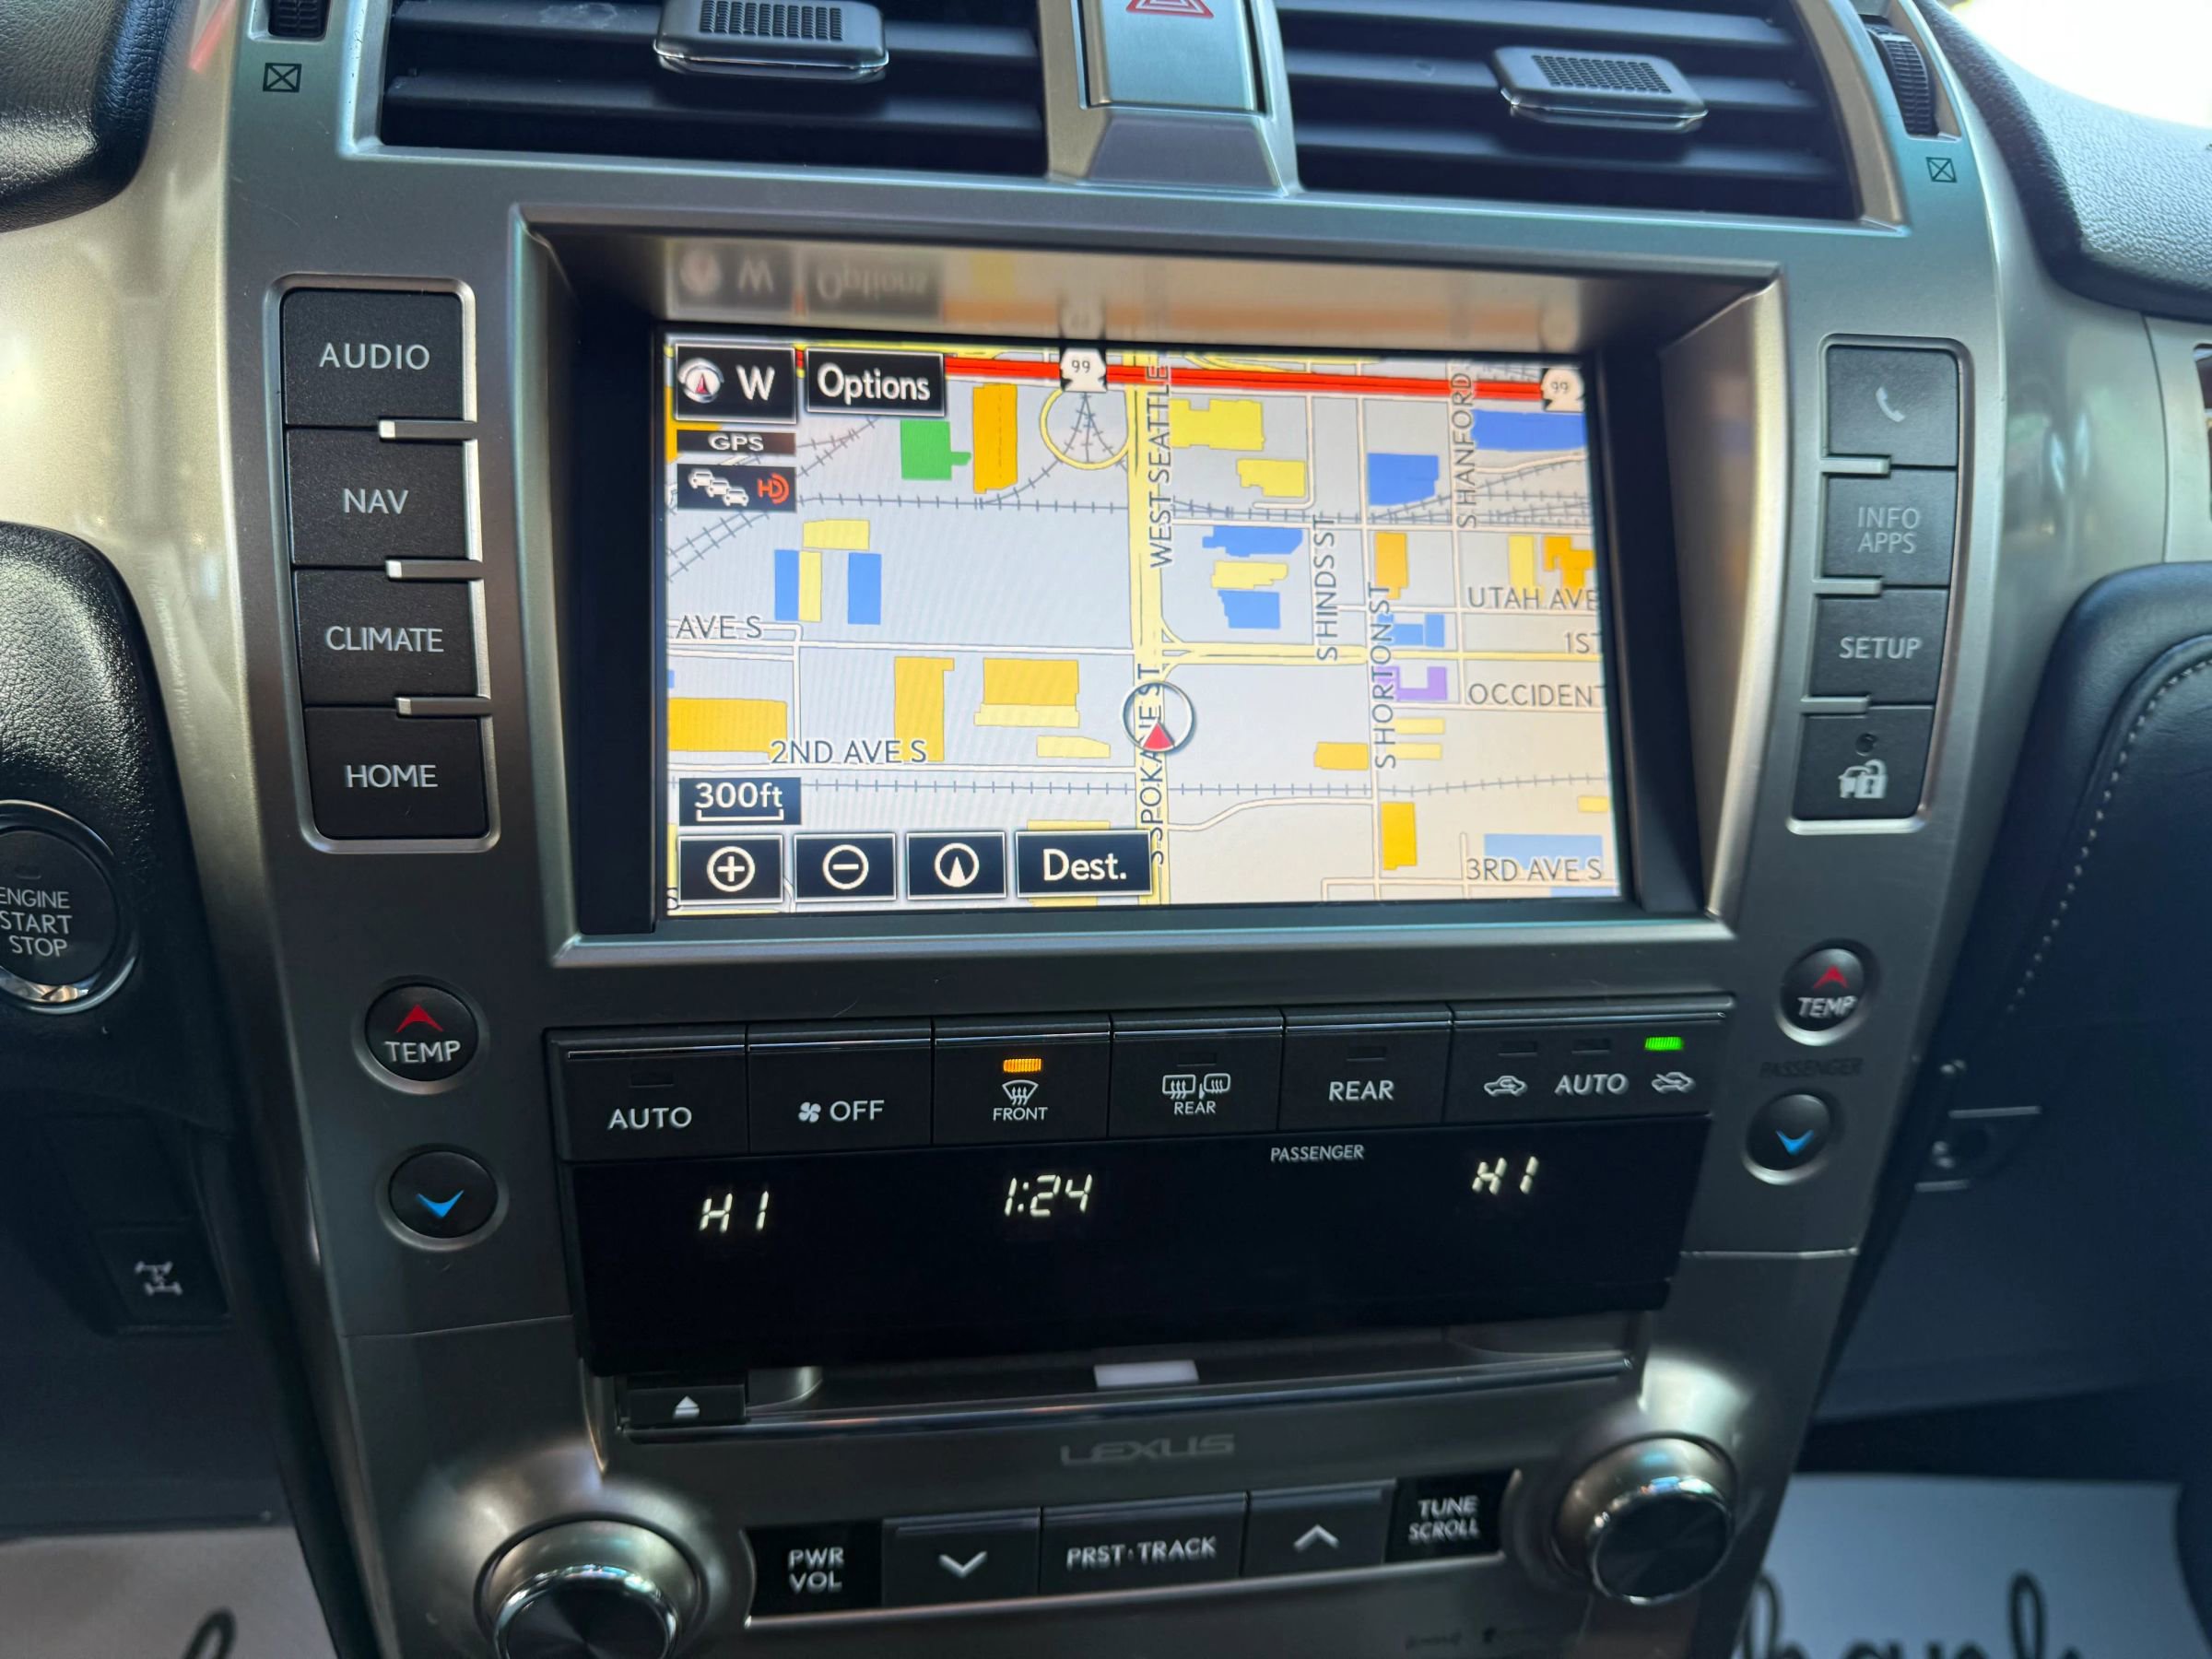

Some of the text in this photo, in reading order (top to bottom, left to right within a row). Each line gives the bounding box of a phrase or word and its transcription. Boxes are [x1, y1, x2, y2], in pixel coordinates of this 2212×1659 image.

[319, 342, 430, 371] AUDIO
[1071, 359, 1091, 373] 99
[736, 365, 776, 400] W
[817, 361, 931, 406] Options
[1550, 381, 1570, 393] 99
[708, 432, 764, 452] GPS
[1450, 372, 1477, 506] HANFORD
[1146, 365, 1173, 569] WEST SEATTLE
[342, 488, 410, 515] NAV
[1456, 514, 1477, 529] S
[1856, 505, 1921, 529] INFO
[1856, 531, 1918, 555] APPS
[1312, 514, 1338, 662] S HINDS ST
[1467, 586, 1540, 610] UTAH
[324, 625, 445, 653] CLIMATE
[676, 615, 763, 640] AVE S
[1839, 636, 1923, 661] SETUP
[1368, 582, 1396, 770] S HORTON ST
[771, 739, 927, 764] 2ND AVE S
[346, 763, 439, 789] HOME
[694, 782, 783, 809] 300ft
[1042, 849, 1127, 881] Dest.
[1466, 857, 1602, 882] 3RD AVE S
[0, 910, 73, 935] START
[8, 935, 67, 957] STOP
[1798, 995, 1858, 1018] TEMP
[383, 1040, 462, 1065] TEMP
[1329, 1079, 1394, 1102] REAR
[1555, 1072, 1629, 1097] AUTO
[607, 1107, 693, 1131] AUTO
[830, 1100, 885, 1124] OFF
[993, 1106, 1048, 1122] FRONT
[1173, 1100, 1216, 1115] REAR
[1270, 1144, 1365, 1163] PASSENGER
[1004, 1173, 1094, 1218] 1:24
[1060, 1433, 1236, 1467] LEXUS
[1418, 1494, 1478, 1519] TUNE
[1407, 1516, 1480, 1543] SCROLL
[788, 1546, 845, 1571] PWR
[789, 1571, 843, 1594] VOL
